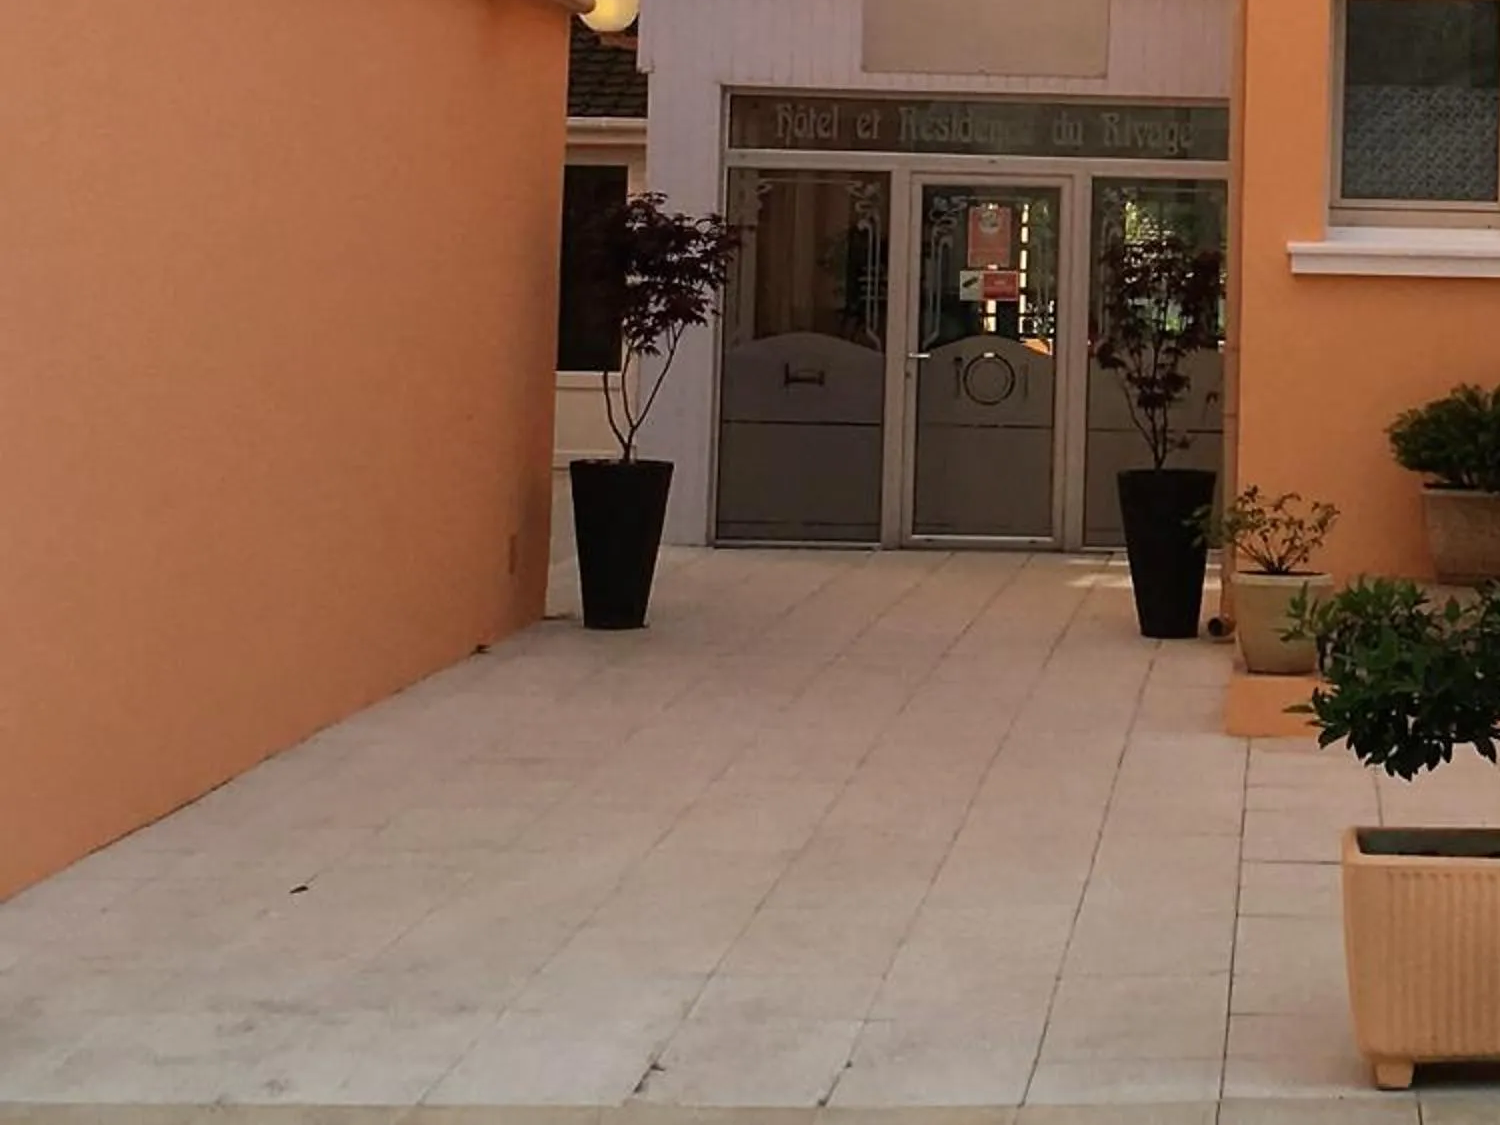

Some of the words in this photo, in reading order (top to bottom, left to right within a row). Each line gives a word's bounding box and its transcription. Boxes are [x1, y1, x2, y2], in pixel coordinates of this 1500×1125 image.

[775, 102, 839, 146] Hôtel
[857, 110, 880, 139] et
[1053, 111, 1083, 146] du
[1101, 112, 1198, 155] Rivage
